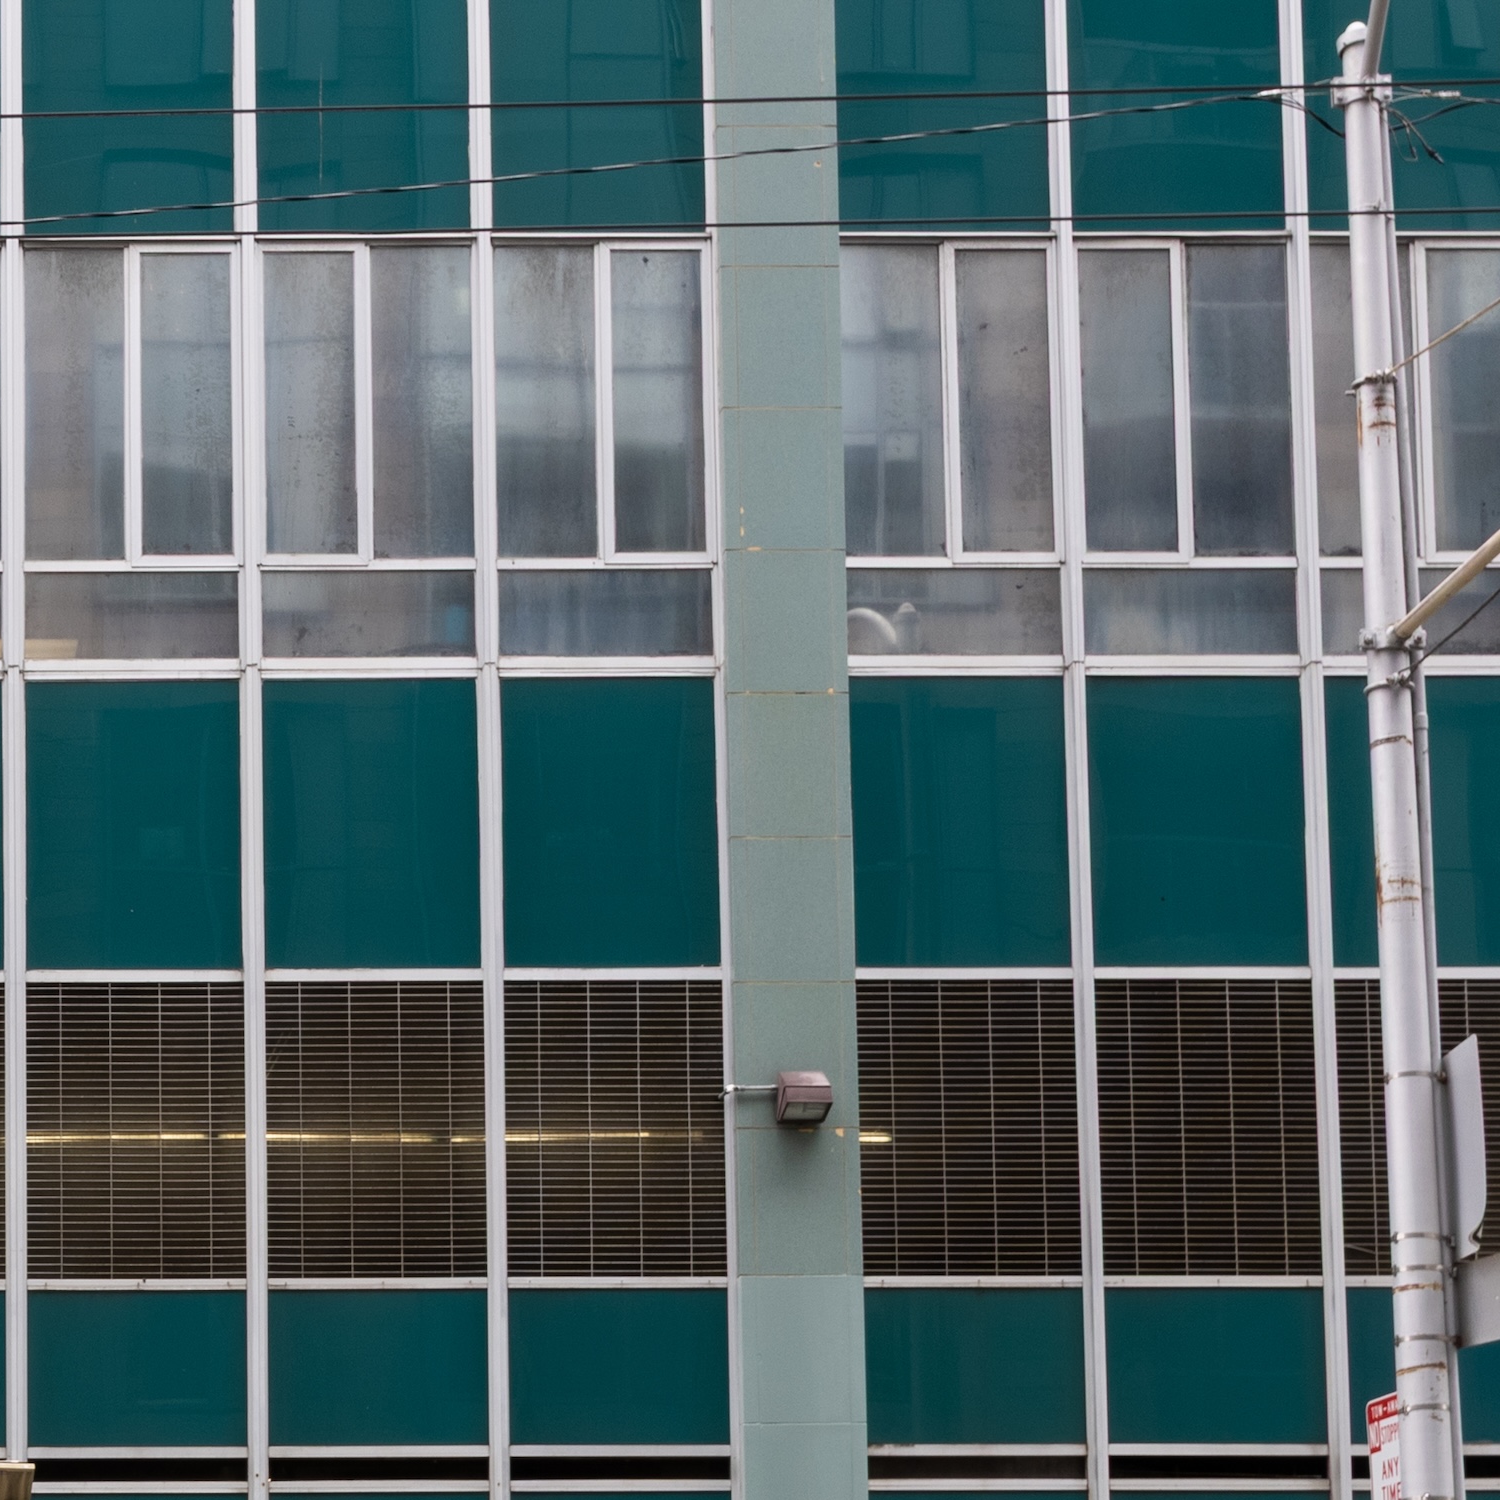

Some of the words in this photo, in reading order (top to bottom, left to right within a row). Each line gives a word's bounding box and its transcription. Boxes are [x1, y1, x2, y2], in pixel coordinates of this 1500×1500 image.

[1369, 1421, 1380, 1449] NO
[1380, 1422, 1399, 1445] STOPP
[1382, 1456, 1399, 1480] ANY
